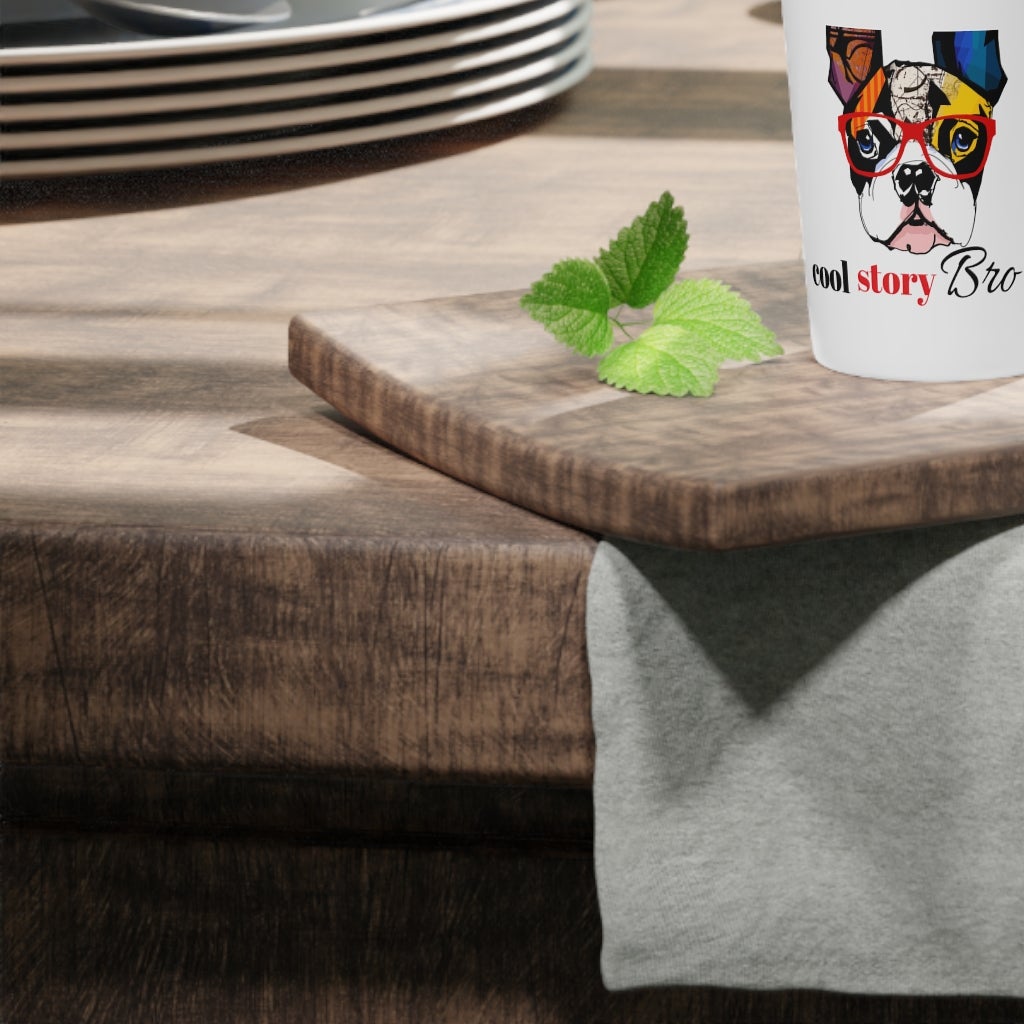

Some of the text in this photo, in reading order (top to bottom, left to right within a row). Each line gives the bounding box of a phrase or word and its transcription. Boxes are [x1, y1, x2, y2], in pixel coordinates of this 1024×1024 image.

[812, 246, 1022, 306] cool story Bro
